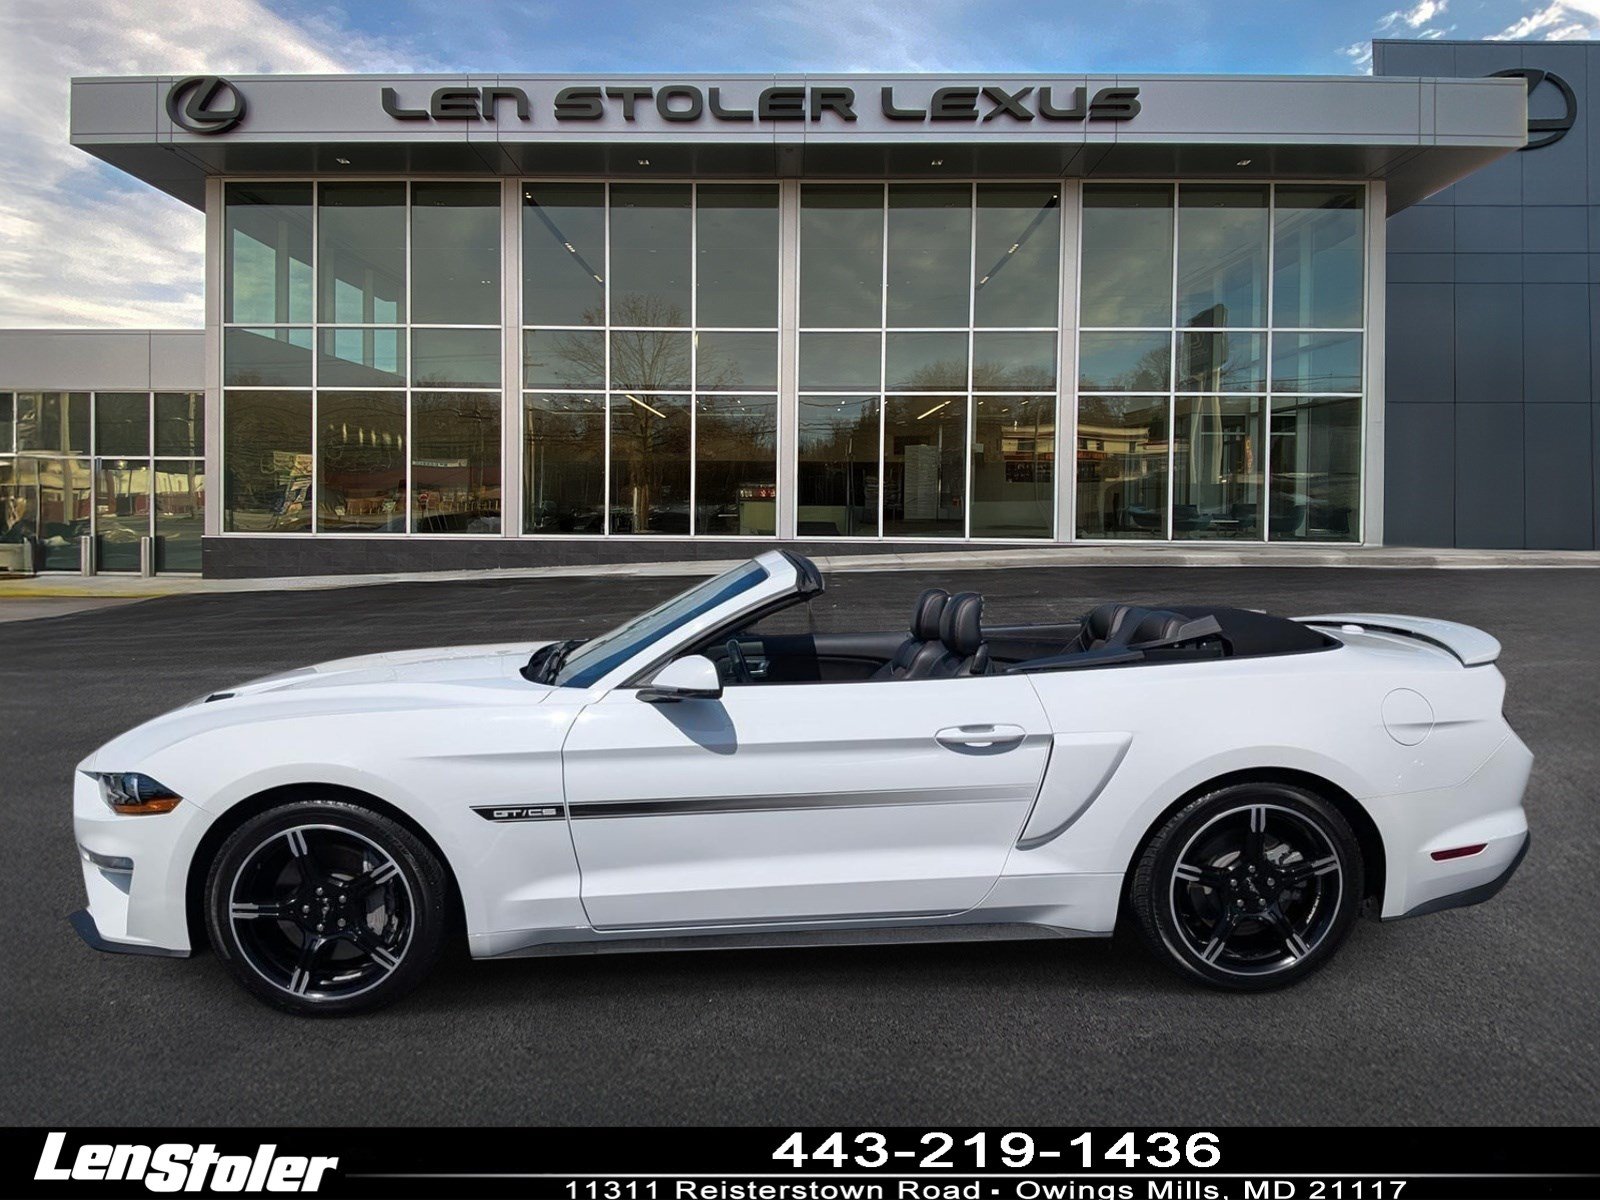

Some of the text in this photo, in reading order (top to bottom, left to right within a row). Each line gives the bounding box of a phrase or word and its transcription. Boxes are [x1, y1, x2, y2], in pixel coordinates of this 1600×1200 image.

[381, 85, 1142, 121] LEN STOLER LEXUS
